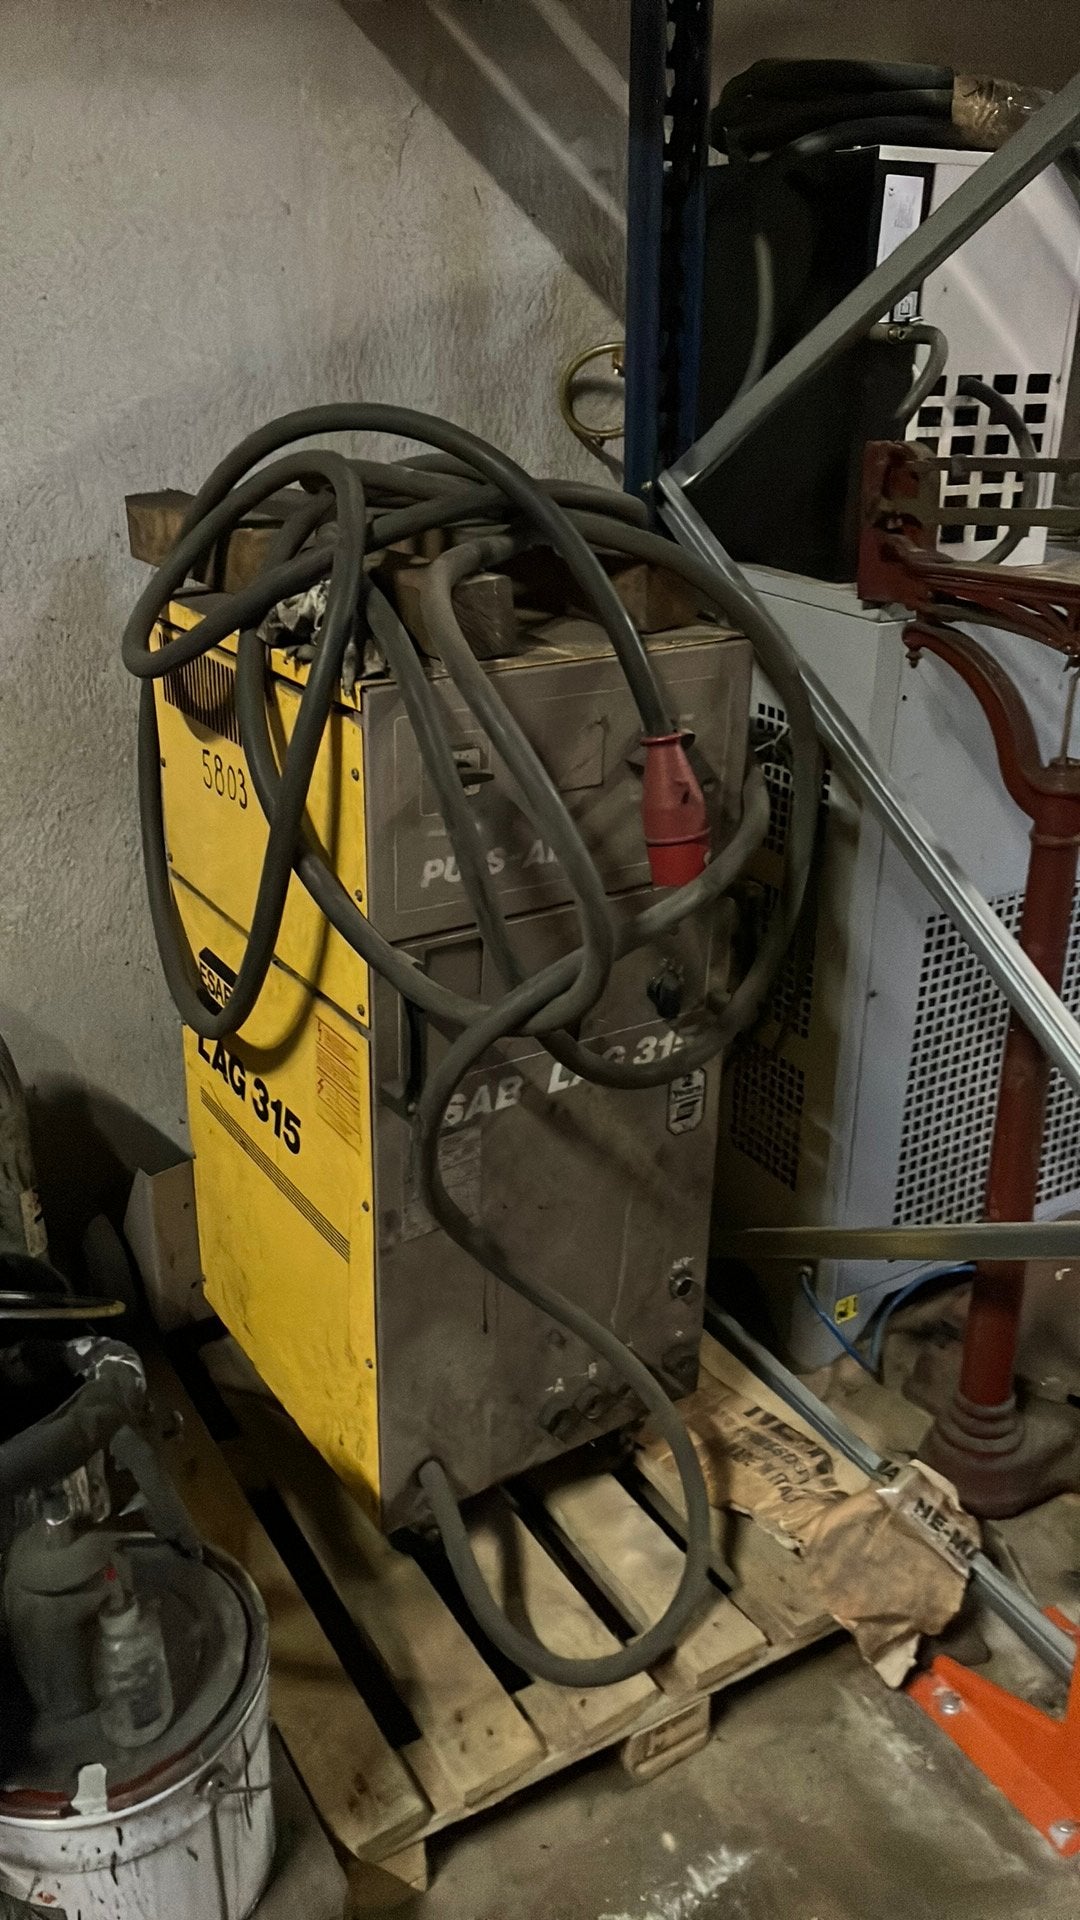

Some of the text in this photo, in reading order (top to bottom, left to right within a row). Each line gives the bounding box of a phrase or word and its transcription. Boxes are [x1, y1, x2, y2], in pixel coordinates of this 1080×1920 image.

[202, 749, 247, 809] 5803
[420, 846, 505, 888] PUS
[198, 1035, 246, 1102] LAG
[252, 1077, 301, 1156] 315
[443, 1075, 524, 1127] SAB
